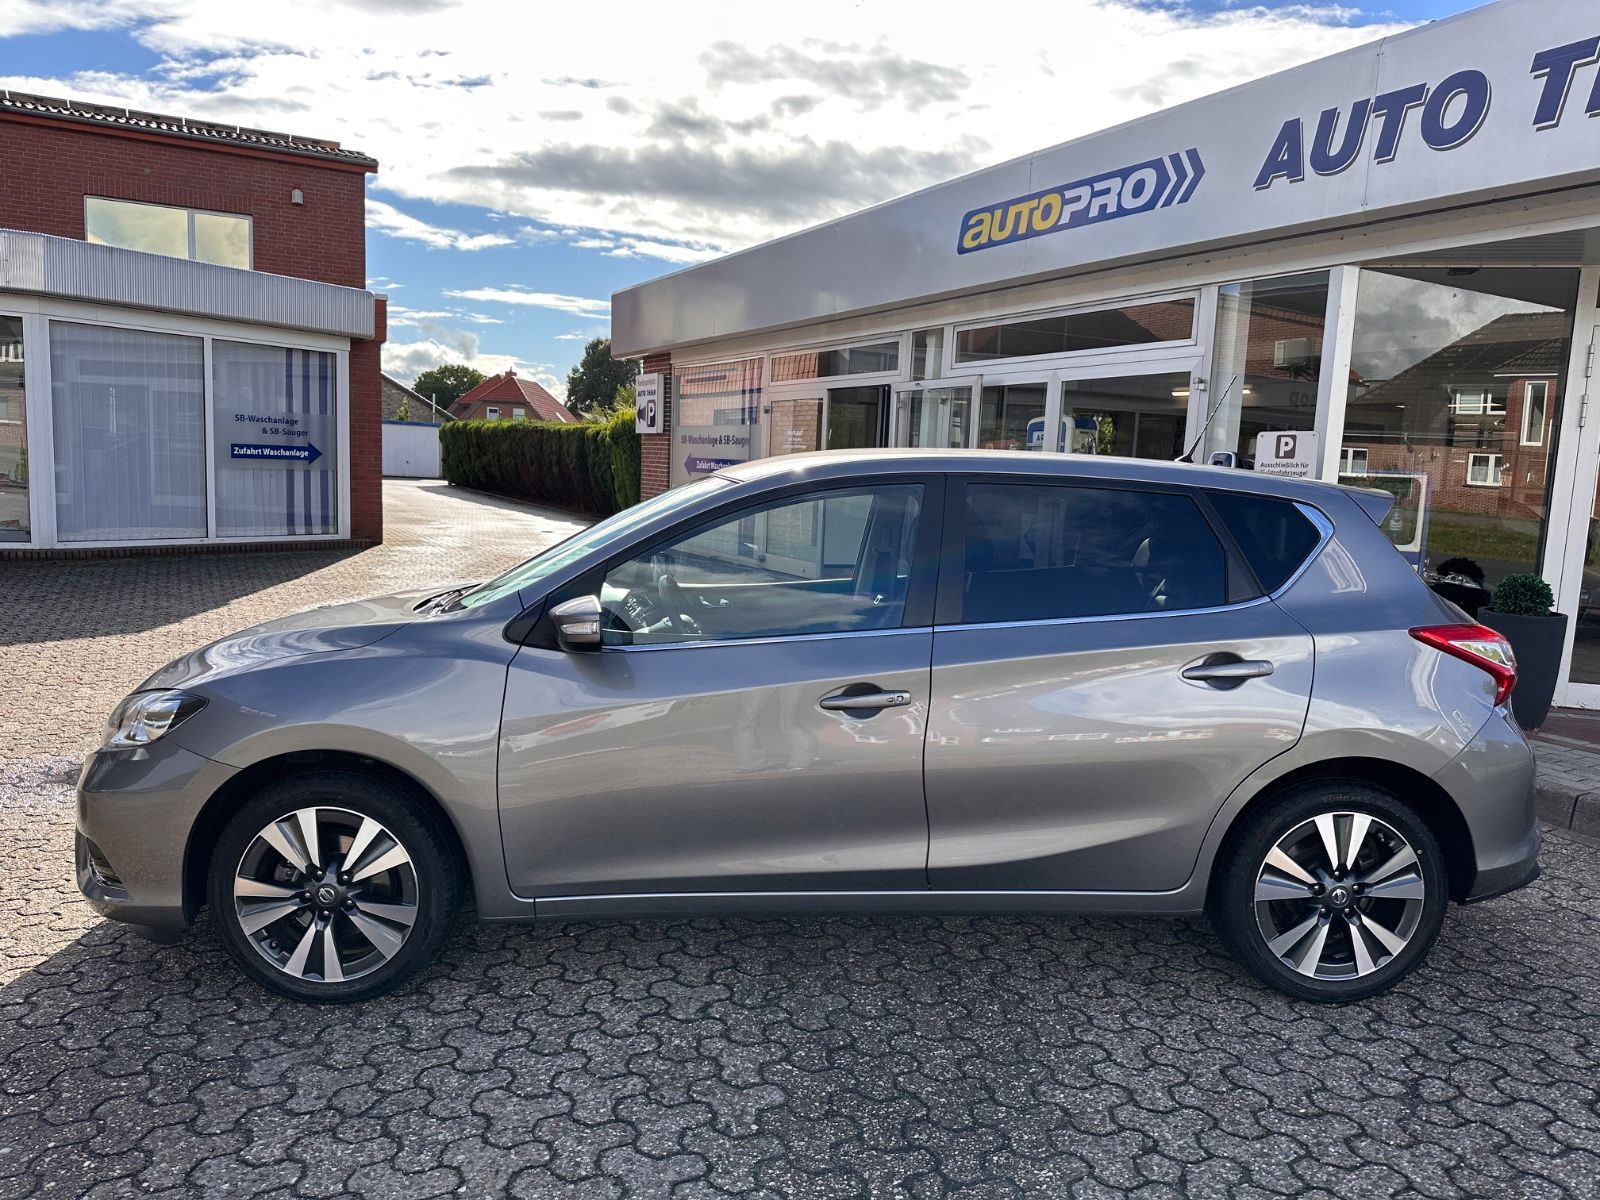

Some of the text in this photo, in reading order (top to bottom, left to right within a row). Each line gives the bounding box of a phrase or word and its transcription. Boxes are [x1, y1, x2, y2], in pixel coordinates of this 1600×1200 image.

[1253, 70, 1491, 191] AUTO
[235, 413, 299, 426] SB-Waschanlage
[269, 427, 308, 437] SB-Sauger
[681, 435, 718, 447] SB-Waschanlage
[233, 447, 309, 458] Zufahrt Waschanlage
